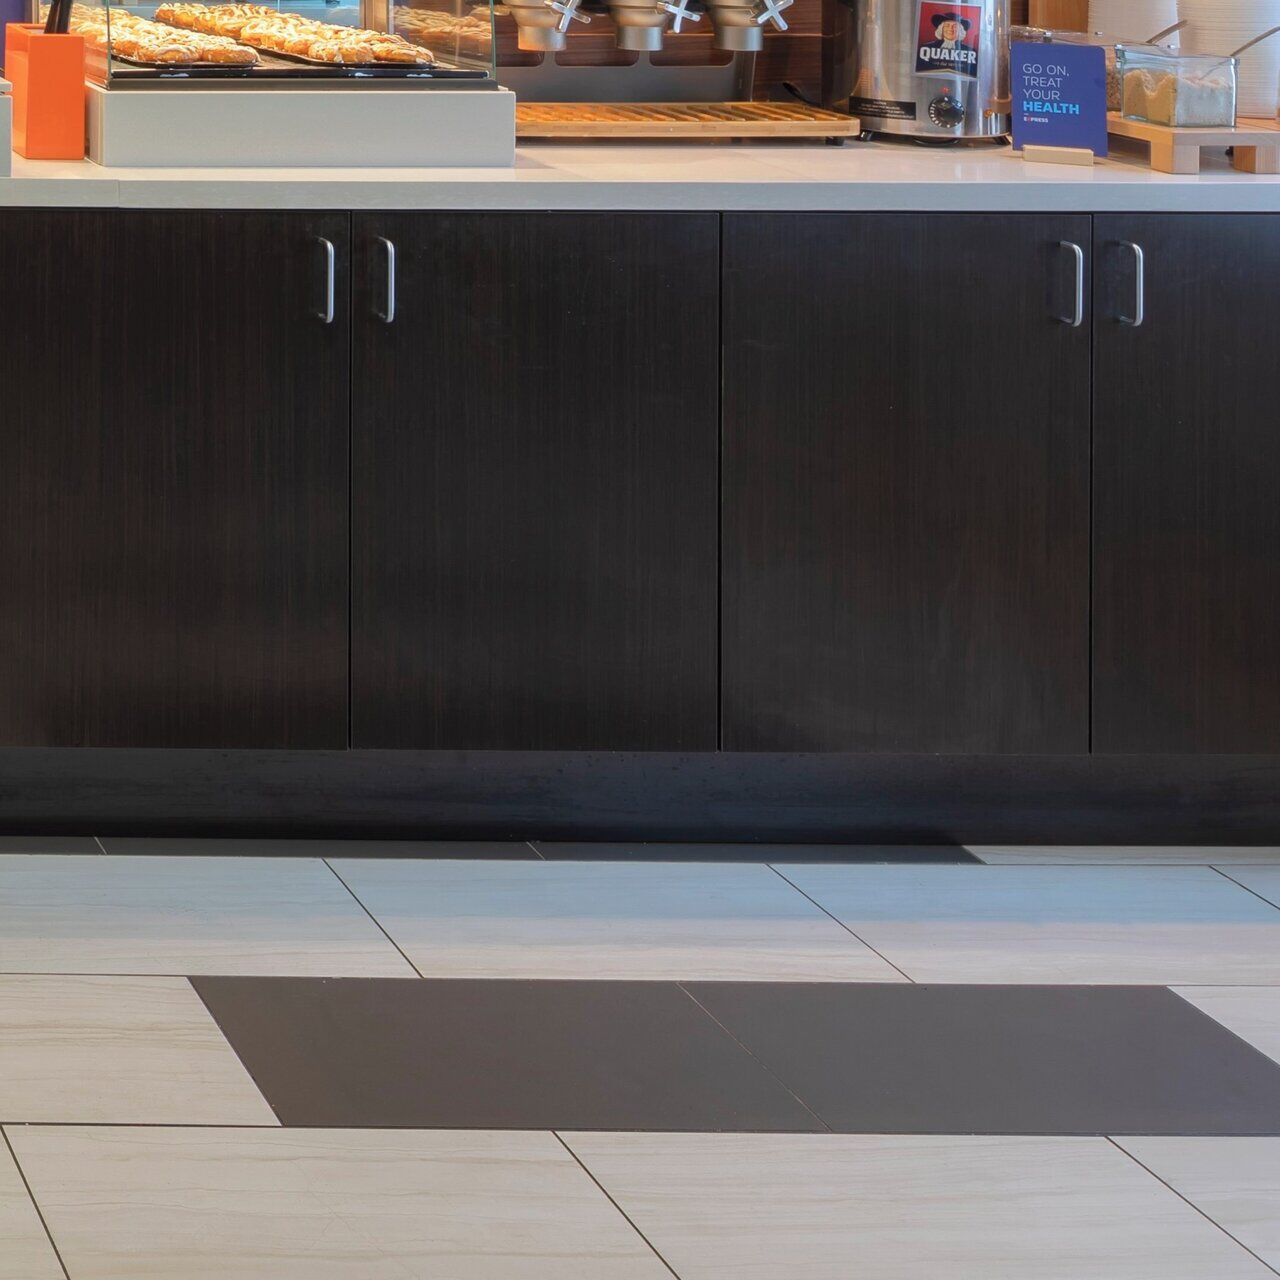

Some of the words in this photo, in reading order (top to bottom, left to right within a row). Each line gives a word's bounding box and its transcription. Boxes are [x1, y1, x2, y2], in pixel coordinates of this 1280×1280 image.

[920, 46, 977, 64] QUAKER
[1023, 63, 1043, 74] GO
[1022, 75, 1063, 88] TREAT
[1023, 89, 1060, 100] YOUR
[1023, 100, 1080, 114] HEALTH
